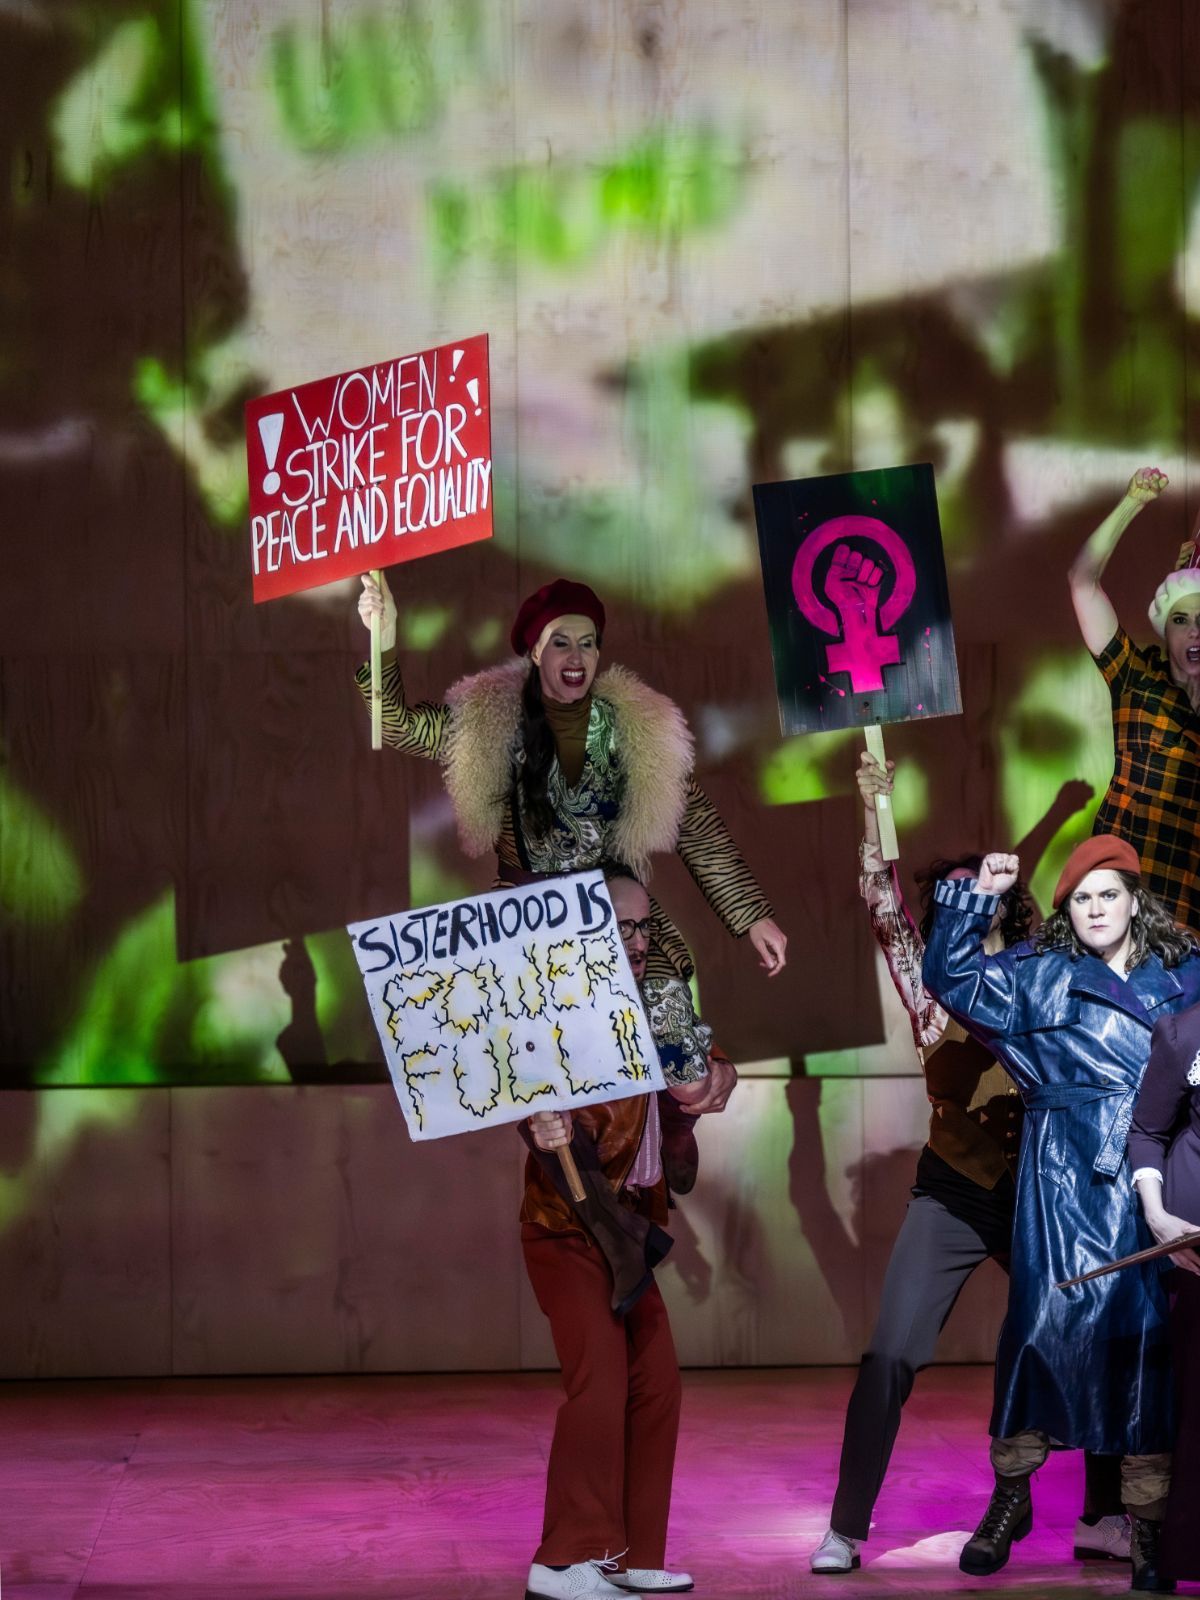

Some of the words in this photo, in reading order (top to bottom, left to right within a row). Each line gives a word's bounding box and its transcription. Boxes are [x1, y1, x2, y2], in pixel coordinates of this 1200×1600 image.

[282, 423, 388, 506] STRIKE
[401, 404, 467, 475] FOR
[252, 499, 327, 575] PEACE
[334, 486, 388, 552] AND
[394, 458, 491, 536] EQUALITY
[358, 889, 568, 973] SISTERHOOD
[576, 880, 613, 935] IS
[383, 929, 640, 1053] POWER
